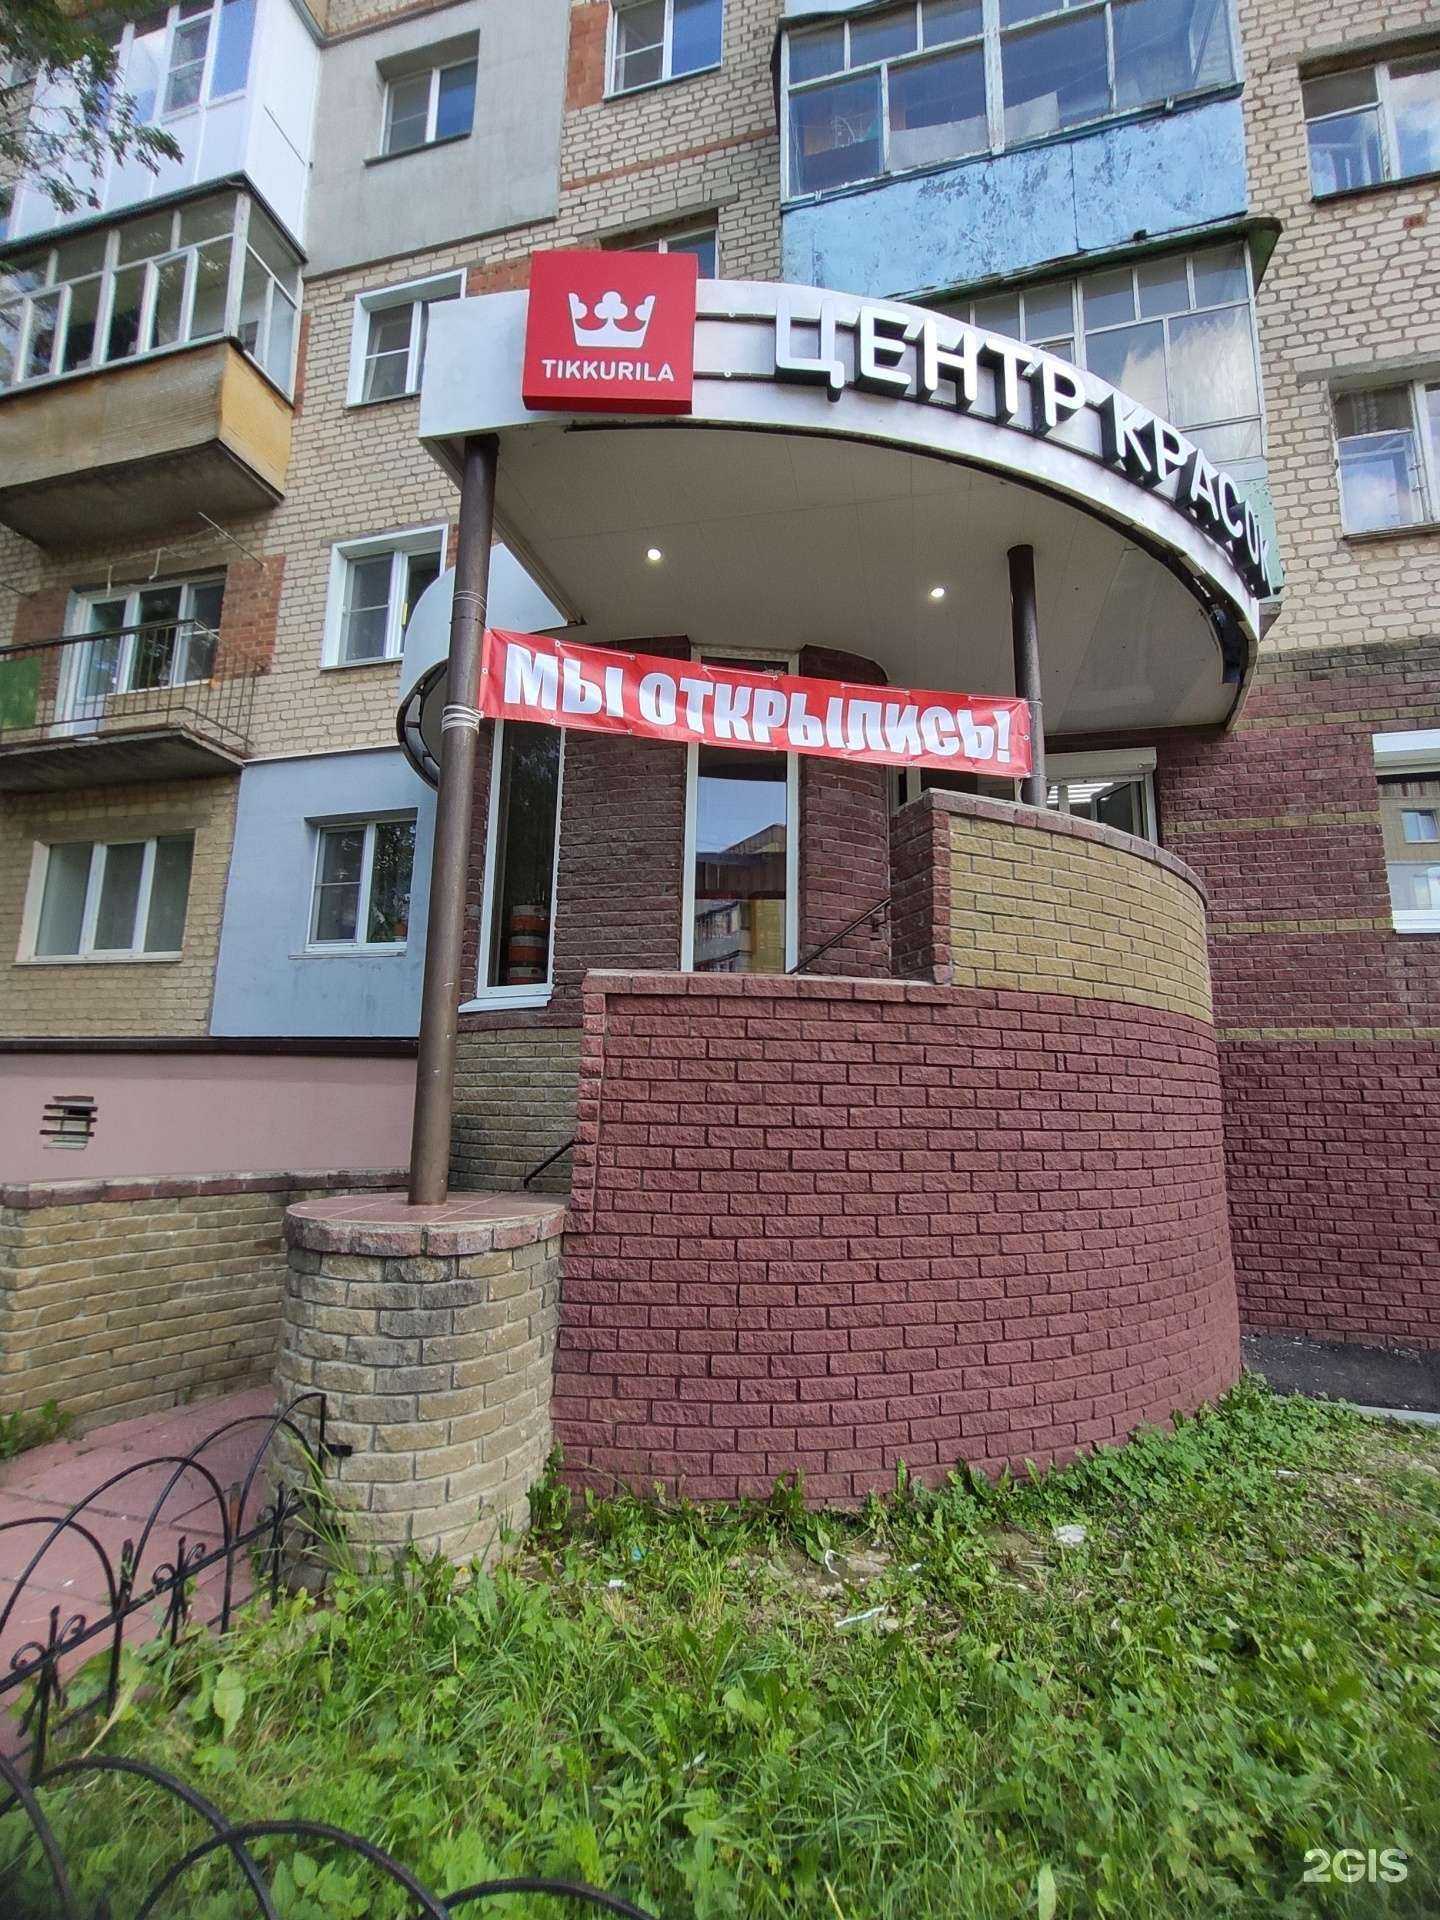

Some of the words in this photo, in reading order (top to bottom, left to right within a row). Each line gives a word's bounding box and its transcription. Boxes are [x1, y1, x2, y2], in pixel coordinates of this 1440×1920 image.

[541, 359, 675, 382] TIKKURILA
[775, 298, 1086, 427] ЦЕНТР
[1110, 392, 1273, 596] КРАСОК
[504, 643, 624, 718] МЫ
[639, 672, 1010, 763] ОТКРЫЛИСЬ!
